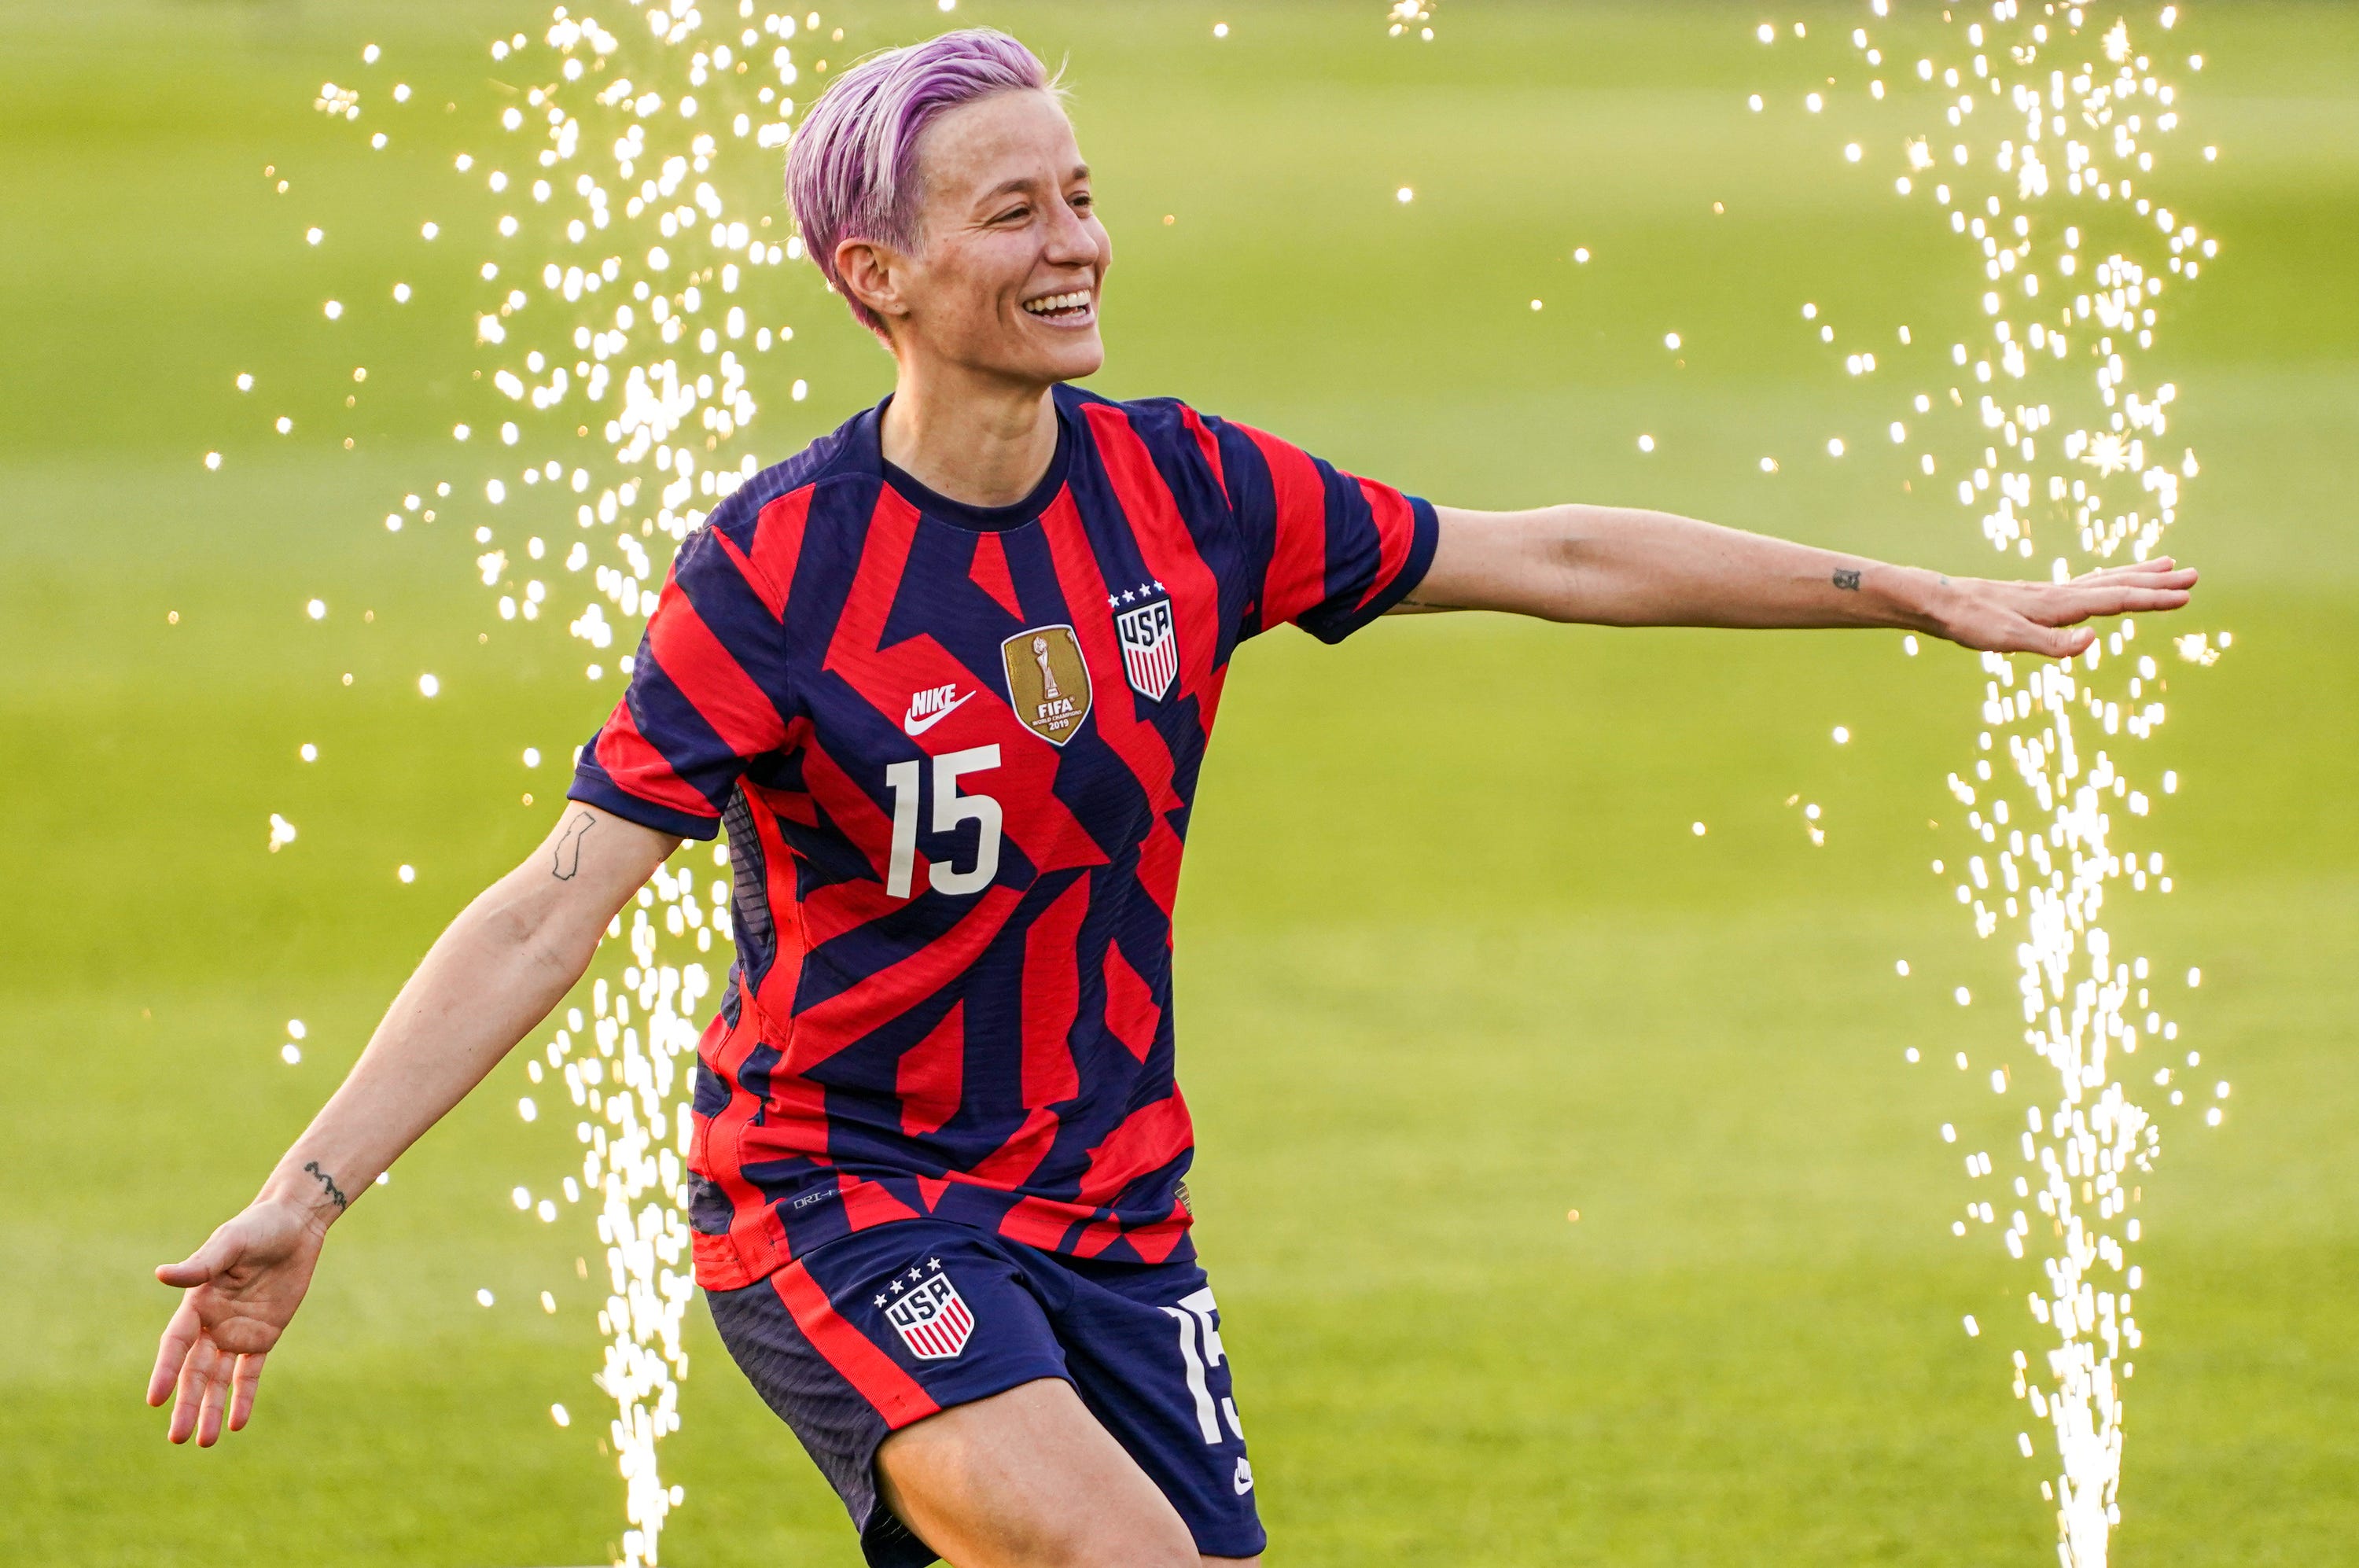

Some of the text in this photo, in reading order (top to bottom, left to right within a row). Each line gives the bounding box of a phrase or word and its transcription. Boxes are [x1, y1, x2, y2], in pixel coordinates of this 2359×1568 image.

[1121, 604, 1169, 647] USA
[911, 683, 956, 718] NIKE
[1032, 709, 1083, 727] WORLD CHAMPIONS
[1037, 698, 1073, 719] FIFA
[1048, 719, 1069, 731] 2019
[885, 743, 1003, 899] 15
[890, 1277, 951, 1327] USA
